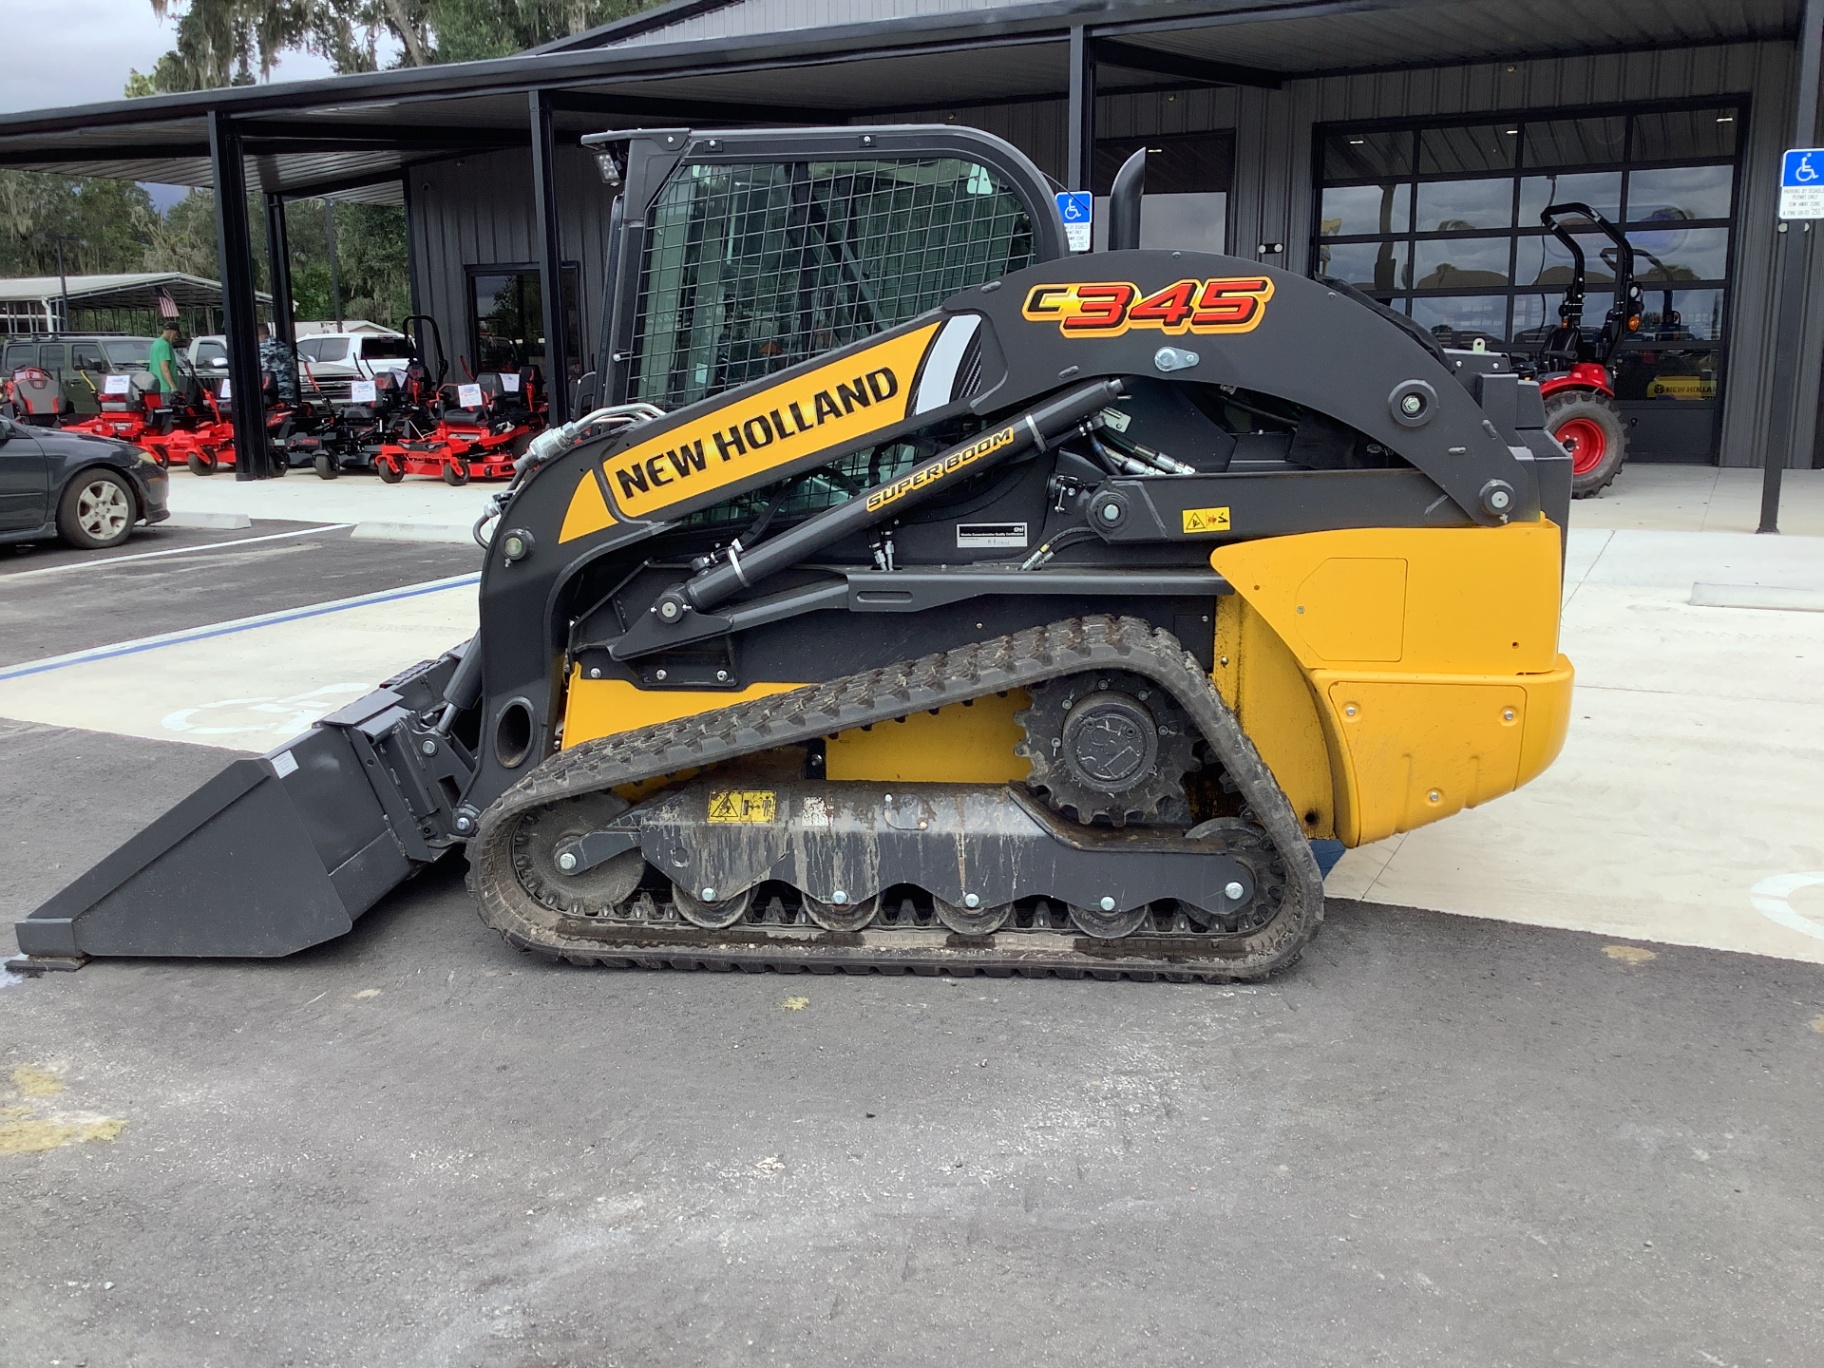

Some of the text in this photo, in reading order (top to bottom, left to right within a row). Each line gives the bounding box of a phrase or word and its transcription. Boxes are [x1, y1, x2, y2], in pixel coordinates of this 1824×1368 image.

[1025, 278, 1270, 332] C345
[615, 366, 899, 499] NEW HOLLAND
[867, 427, 1014, 511] SUPER BOOM
